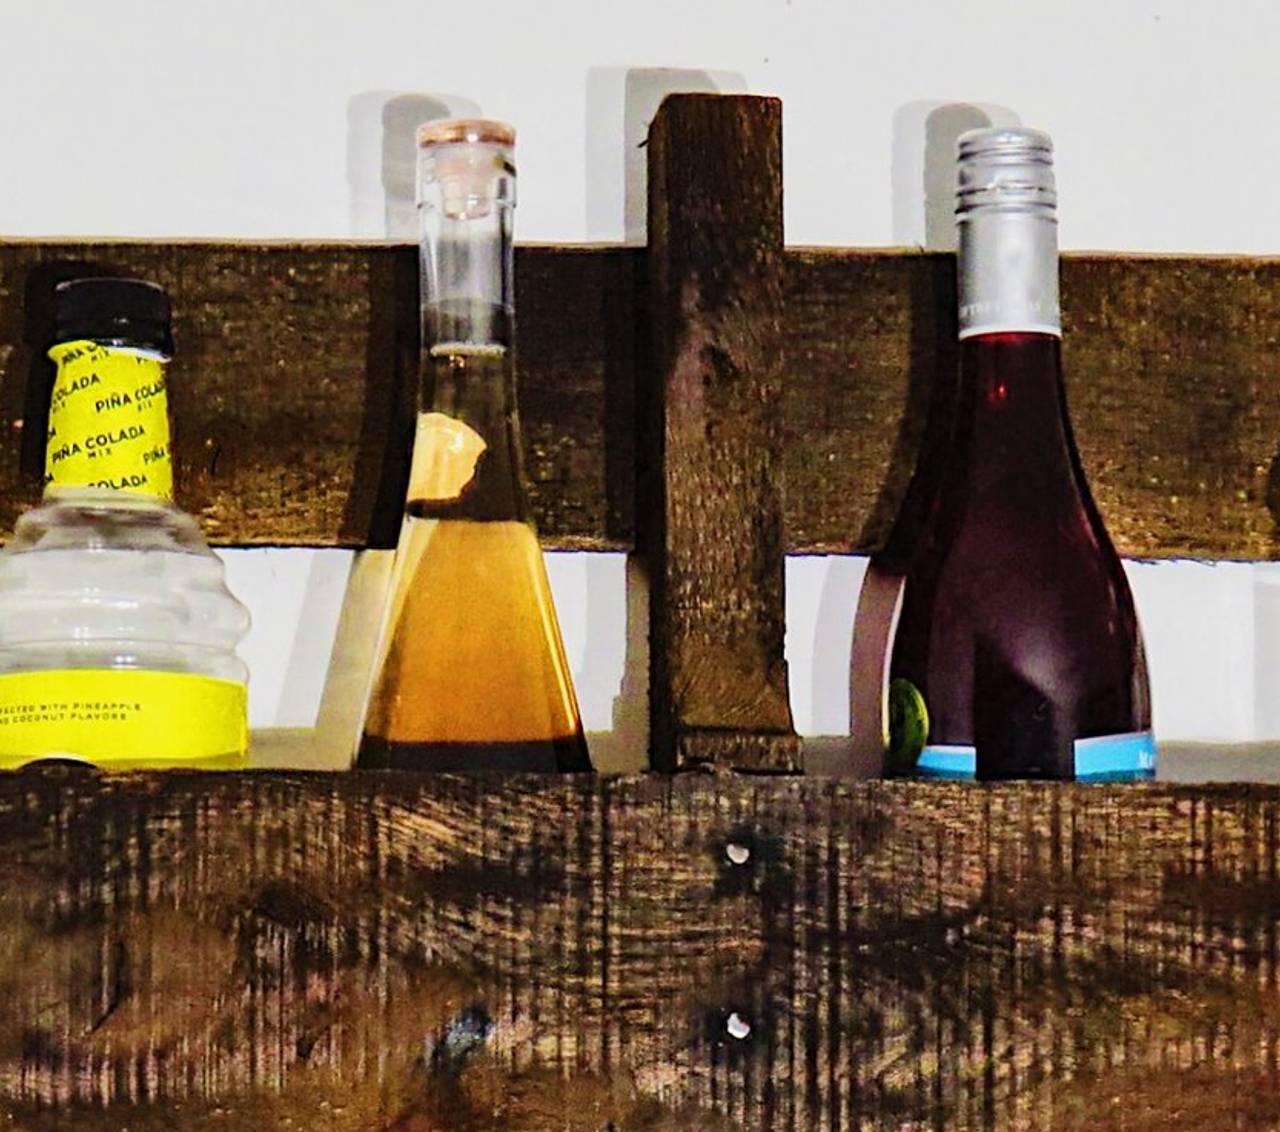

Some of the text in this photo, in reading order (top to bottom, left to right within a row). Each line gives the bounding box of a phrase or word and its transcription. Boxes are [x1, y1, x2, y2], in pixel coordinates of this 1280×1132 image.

[95, 392, 132, 413] PIÑA
[85, 424, 145, 450] COLADA
[87, 447, 112, 460] MIX
[40, 703, 68, 712] WITH
[73, 702, 141, 711] PINEAPPLE
[12, 713, 65, 724] COCONUT
